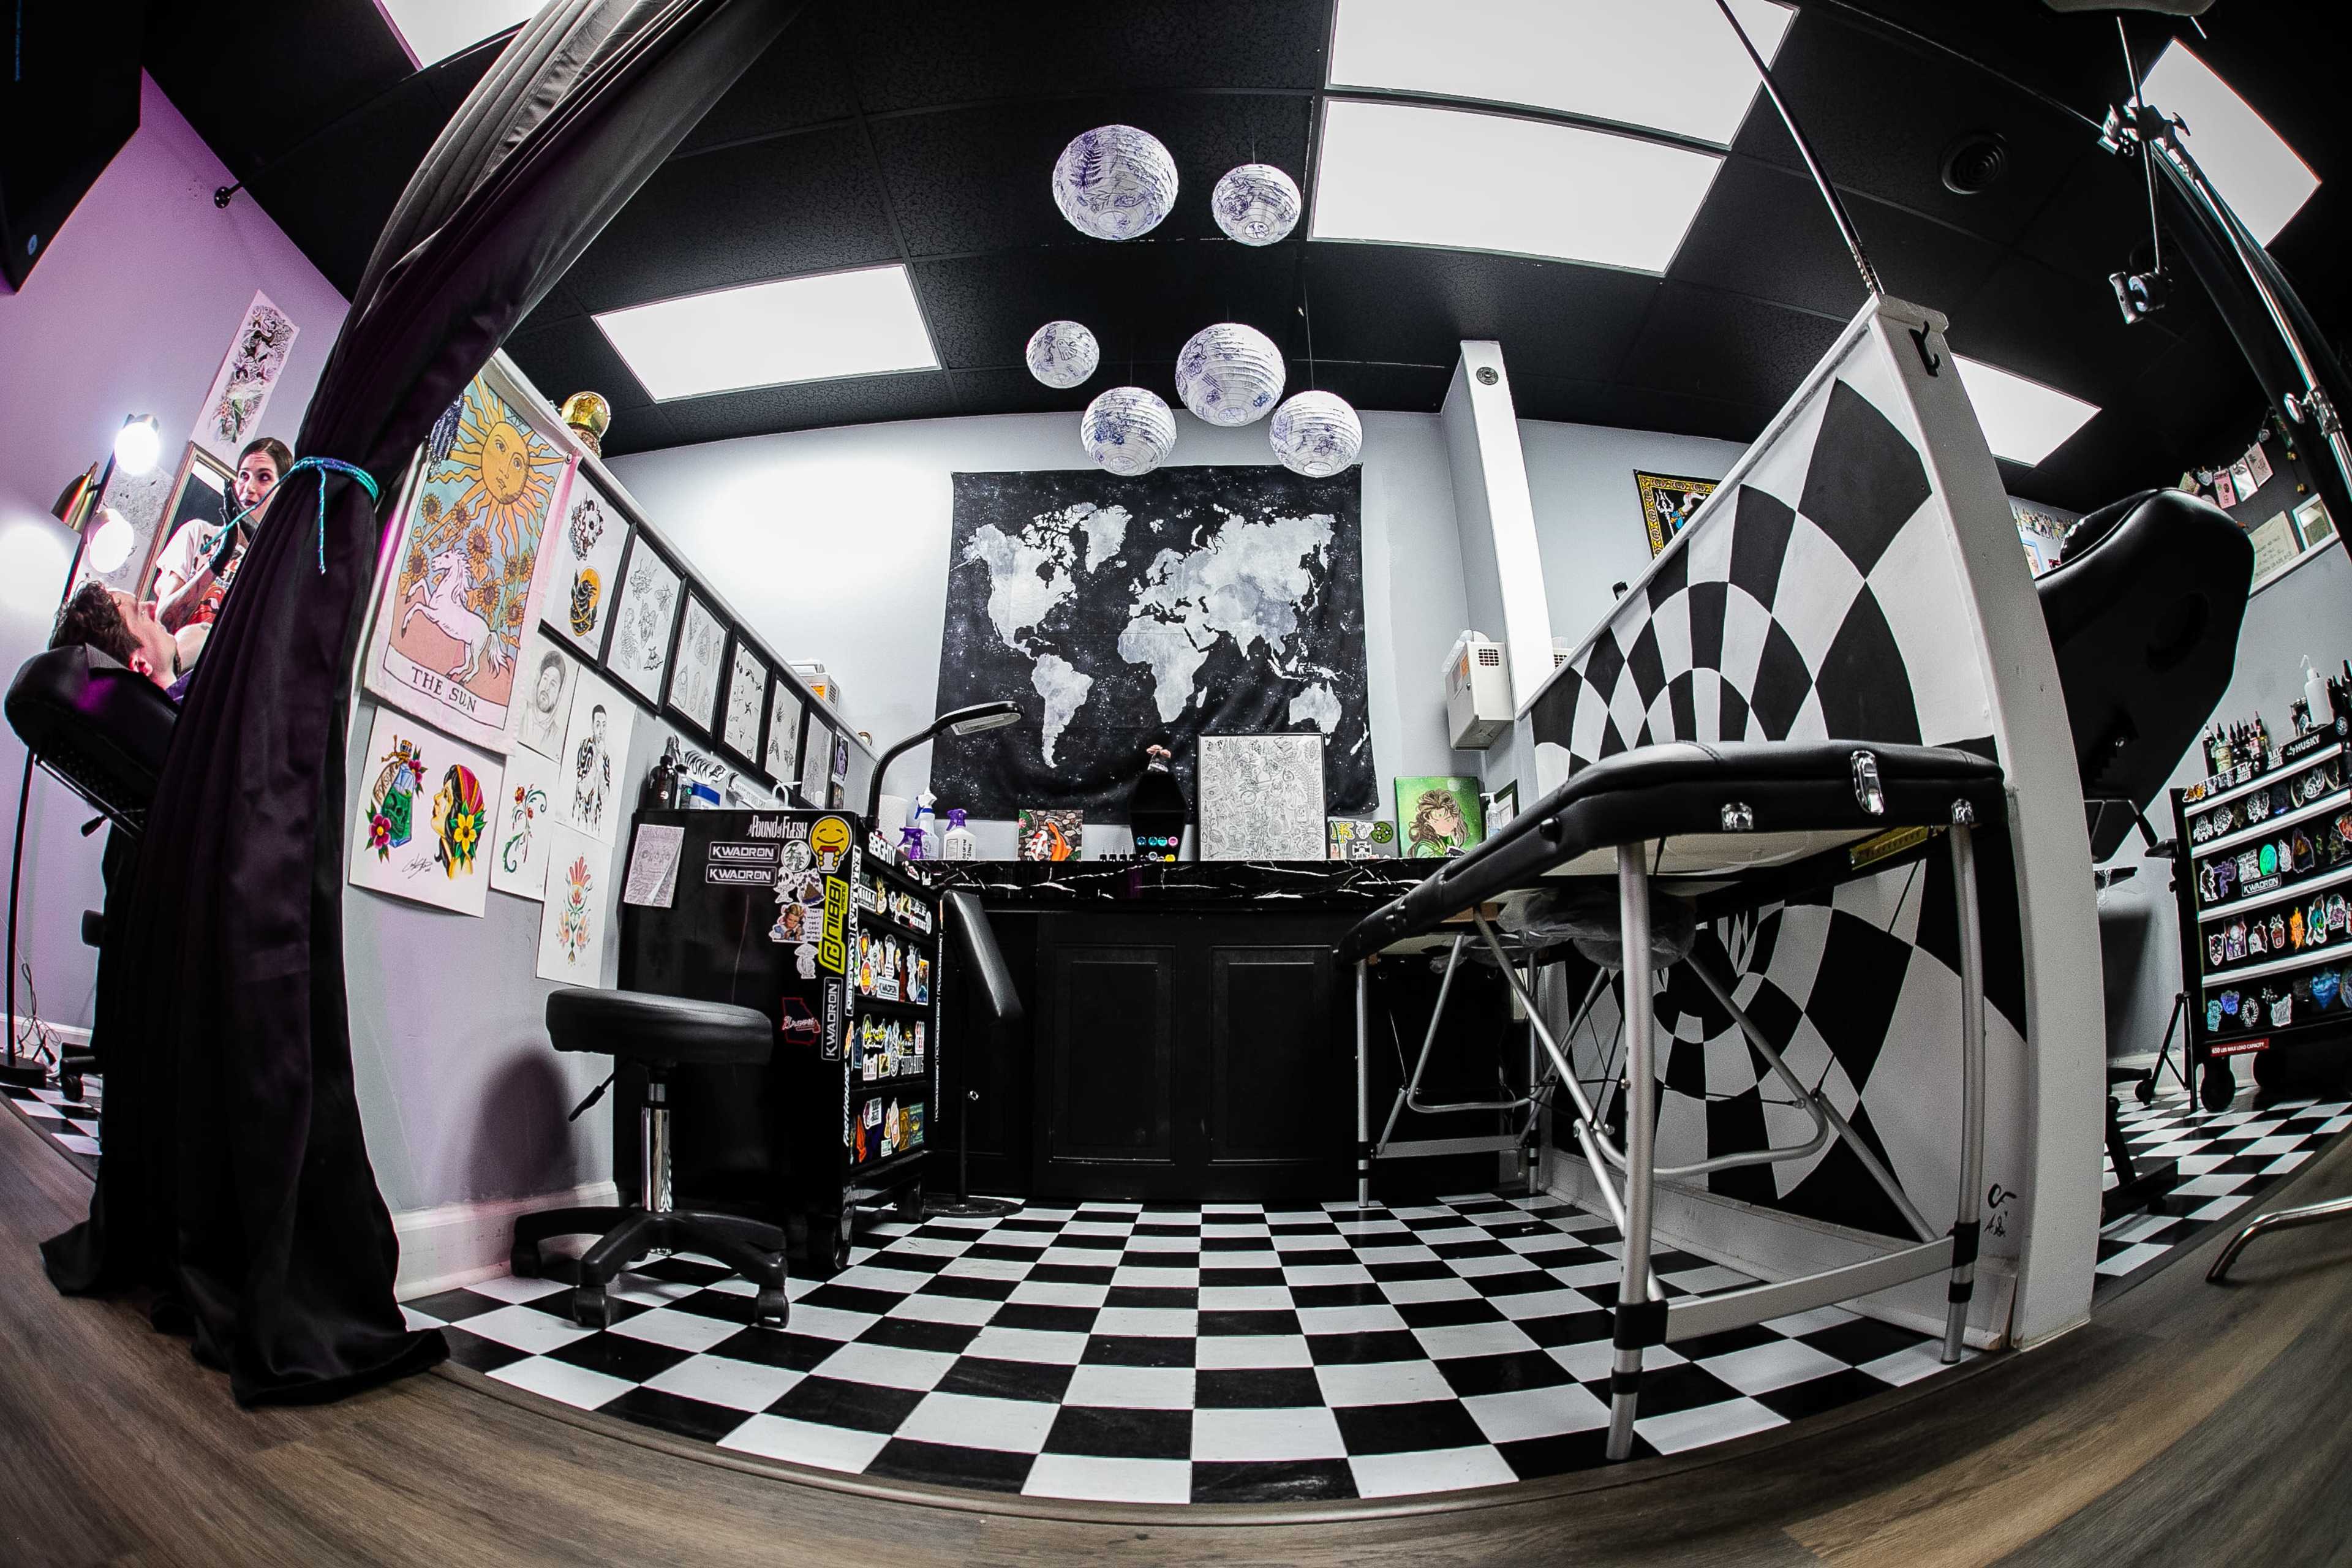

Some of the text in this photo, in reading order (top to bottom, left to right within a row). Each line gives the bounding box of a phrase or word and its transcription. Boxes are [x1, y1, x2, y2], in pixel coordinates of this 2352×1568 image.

[412, 666, 477, 713] THE SUN
[2295, 734, 2320, 753] HUSKY
[752, 815, 778, 838] POUND
[782, 816, 808, 839] FLESH
[712, 846, 774, 859] KWADRON
[709, 869, 771, 882] KWADRON
[2244, 877, 2278, 894] KWADRON
[846, 937, 855, 1011] KWADRON
[826, 984, 840, 1056] KWADRON
